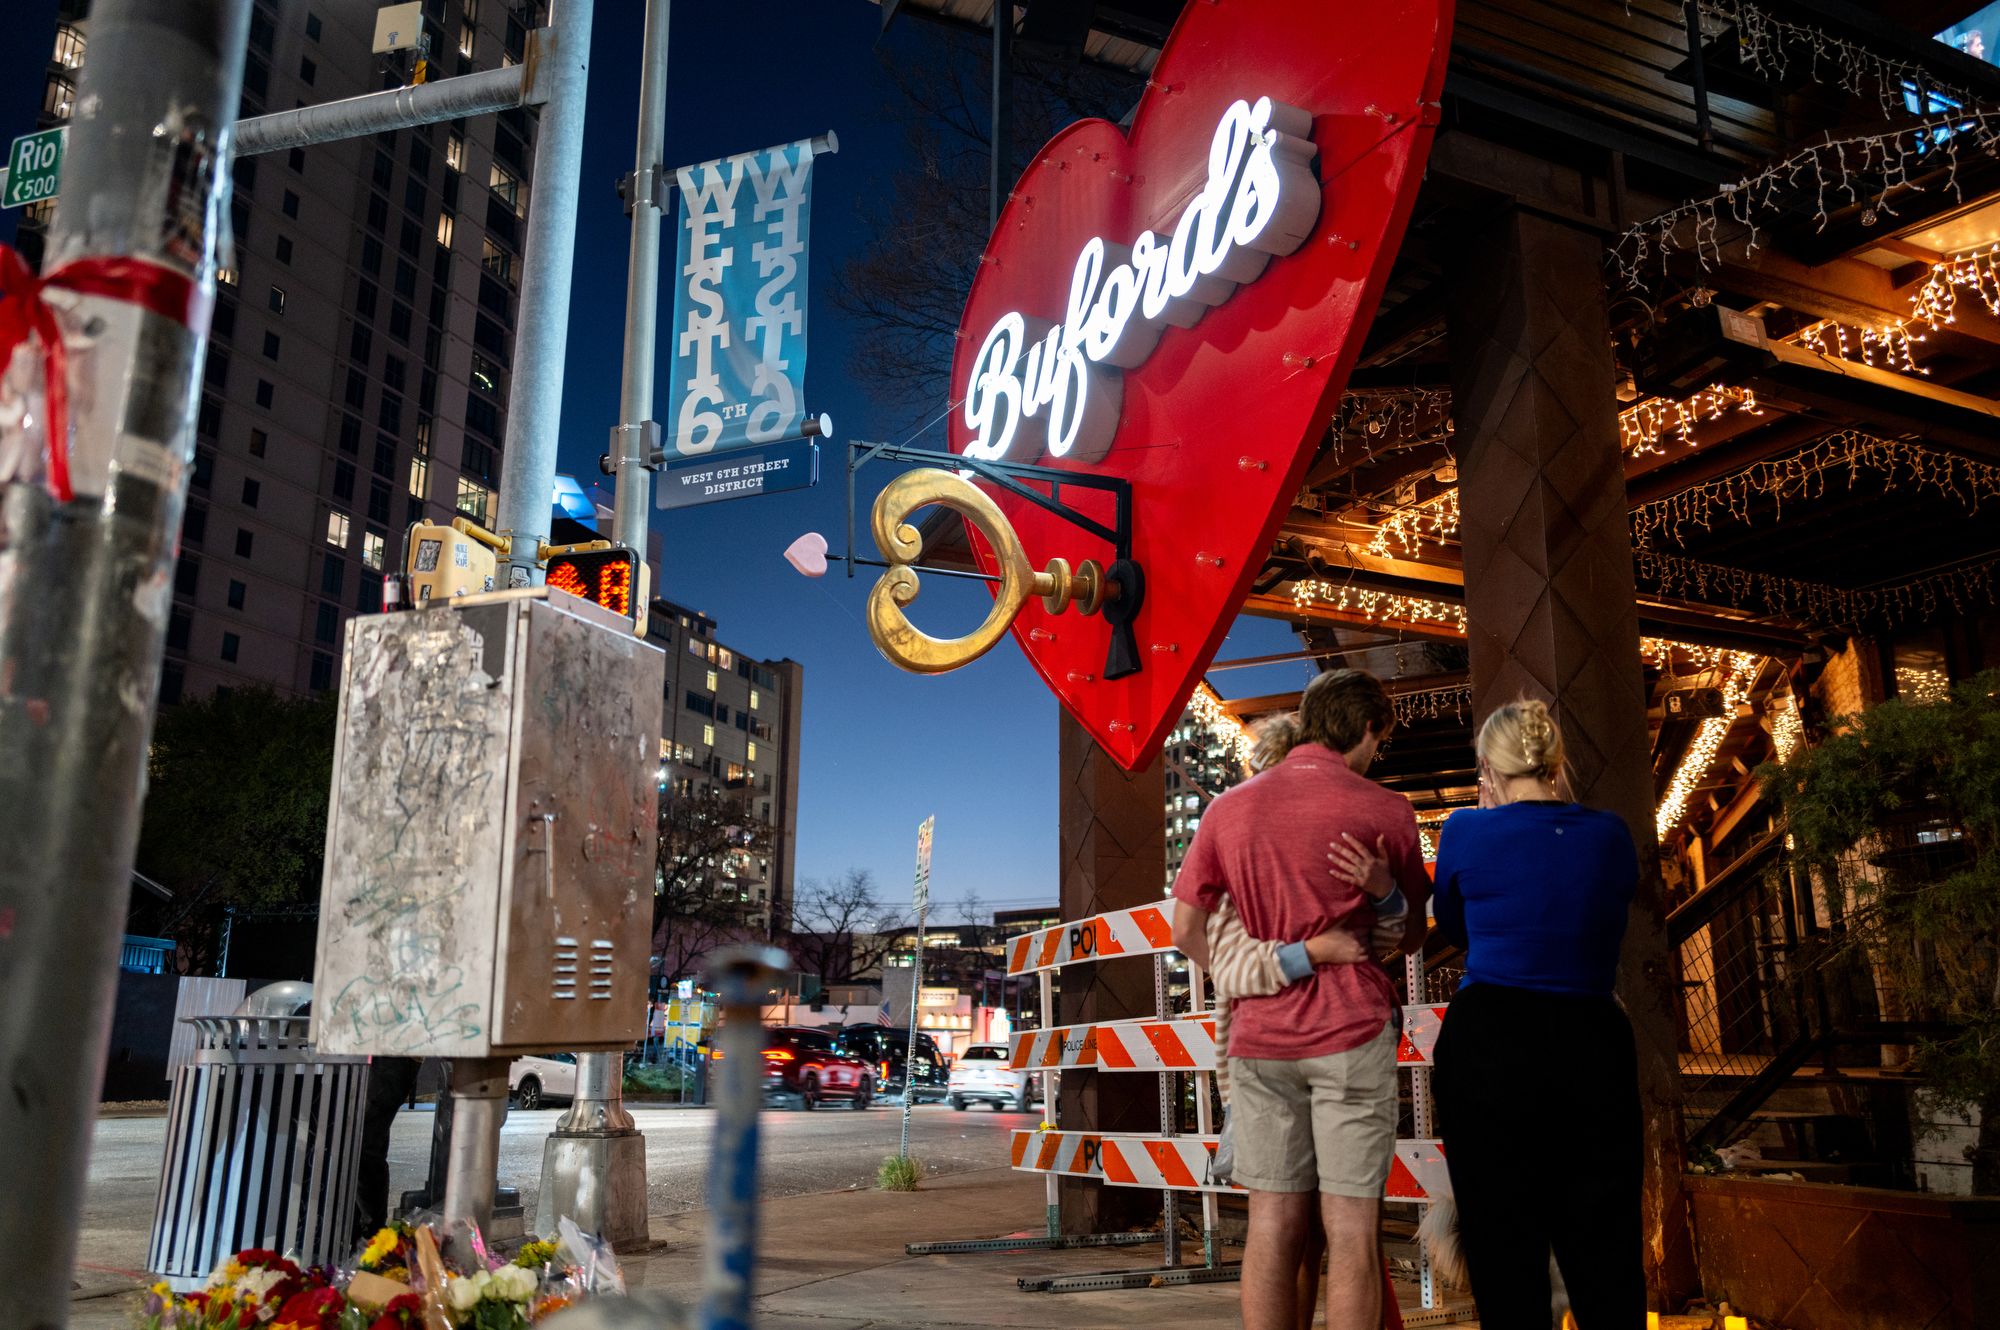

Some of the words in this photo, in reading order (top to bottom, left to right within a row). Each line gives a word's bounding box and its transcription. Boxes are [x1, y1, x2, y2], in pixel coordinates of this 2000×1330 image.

[16, 137, 57, 174] Rio
[23, 175, 55, 199] 500
[676, 153, 746, 392] WEST
[961, 95, 1281, 480] Buford's
[681, 471, 713, 486] WEST
[716, 467, 740, 480] 6TH
[743, 458, 790, 475] STREET
[704, 476, 764, 496] DISTRICT
[1063, 1039, 1084, 1052] POLICE
[1084, 1038, 1098, 1050] LINE
